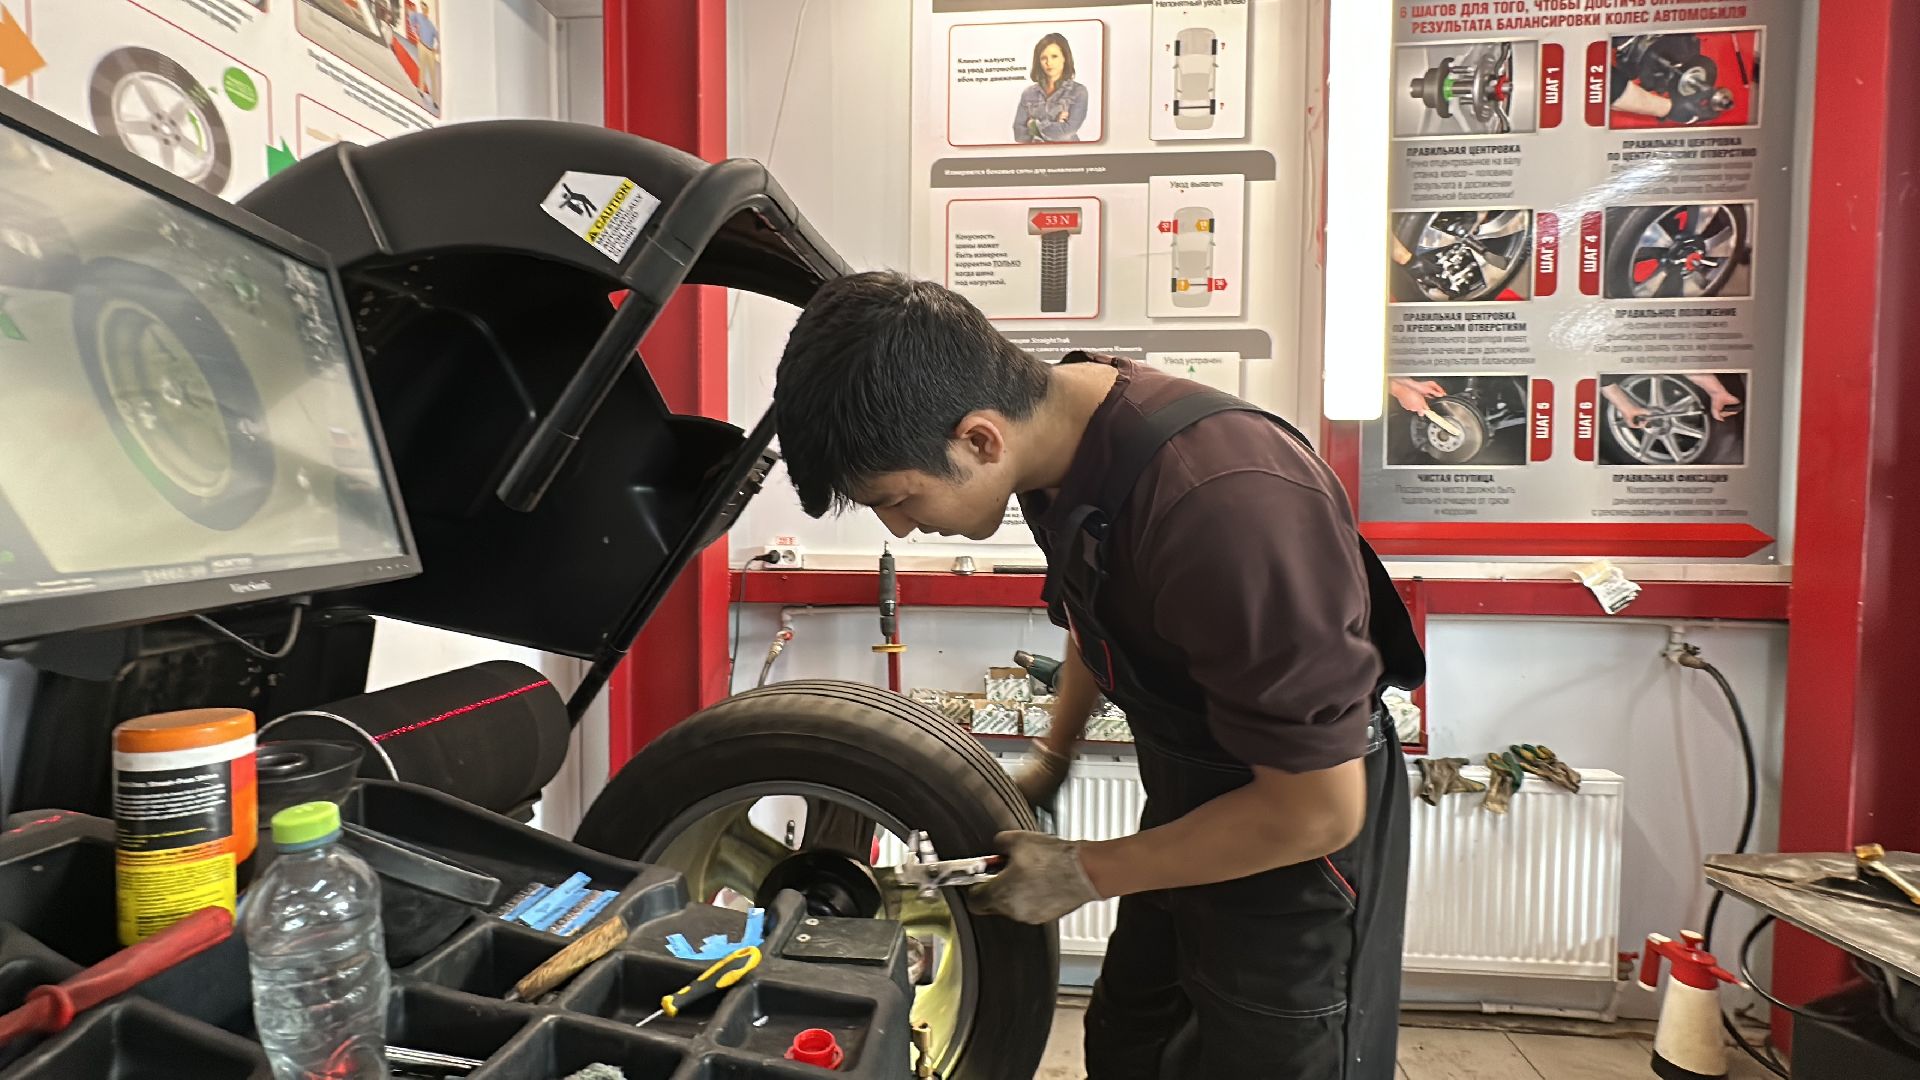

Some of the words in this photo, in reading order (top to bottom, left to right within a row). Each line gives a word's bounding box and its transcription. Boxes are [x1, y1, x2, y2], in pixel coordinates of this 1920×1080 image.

[1400, 7, 1407, 19] 6
[1411, 4, 1456, 18] ШАГОВ
[1460, 3, 1489, 18] ДЛЯ
[1494, 1, 1529, 14] ТОГО,
[1534, 0, 1582, 11] ЧТОБЫ
[1412, 18, 1492, 34] РЕЗУЛЬТАТА
[1496, 12, 1600, 31] БАЛАНСИРОВКИ
[1605, 10, 1649, 25] КОЛЕС
[1653, 6, 1747, 22] АВТОМОБИЛЯ
[1590, 65, 1604, 73] 2
[1545, 77, 1560, 104] ШАГ
[1589, 76, 1604, 104] ШАГ
[1406, 146, 1466, 156] ПРАВИЛЬНАЯ
[1468, 144, 1521, 155] ЦЕНТРОВКА
[1687, 137, 1742, 148] ЦЕНТРОВКА
[594, 183, 631, 230] CAUTION
[1045, 215, 1058, 225] 53
[1059, 215, 1070, 225] N
[1585, 235, 1598, 243] 4
[1540, 249, 1554, 274] ШАГ
[1584, 247, 1598, 273] ШАГ
[1403, 312, 1462, 321] ПРАВИЛЬНАЯ
[1465, 312, 1516, 322] ЦЕНТРОВКА
[1392, 324, 1404, 333] ПО
[1406, 323, 1465, 333] КРЕПЕЖНЫМ
[1467, 323, 1527, 332] ОТВЕРСТИЯМ
[1536, 412, 1550, 439] ШАГ
[1578, 412, 1593, 439] ШАГ
[1417, 474, 1452, 482] ЧИСТАЯ
[1454, 474, 1495, 483] СТУПИЦА
[1612, 474, 1674, 482] ПРАВИЛЬНАЯ
